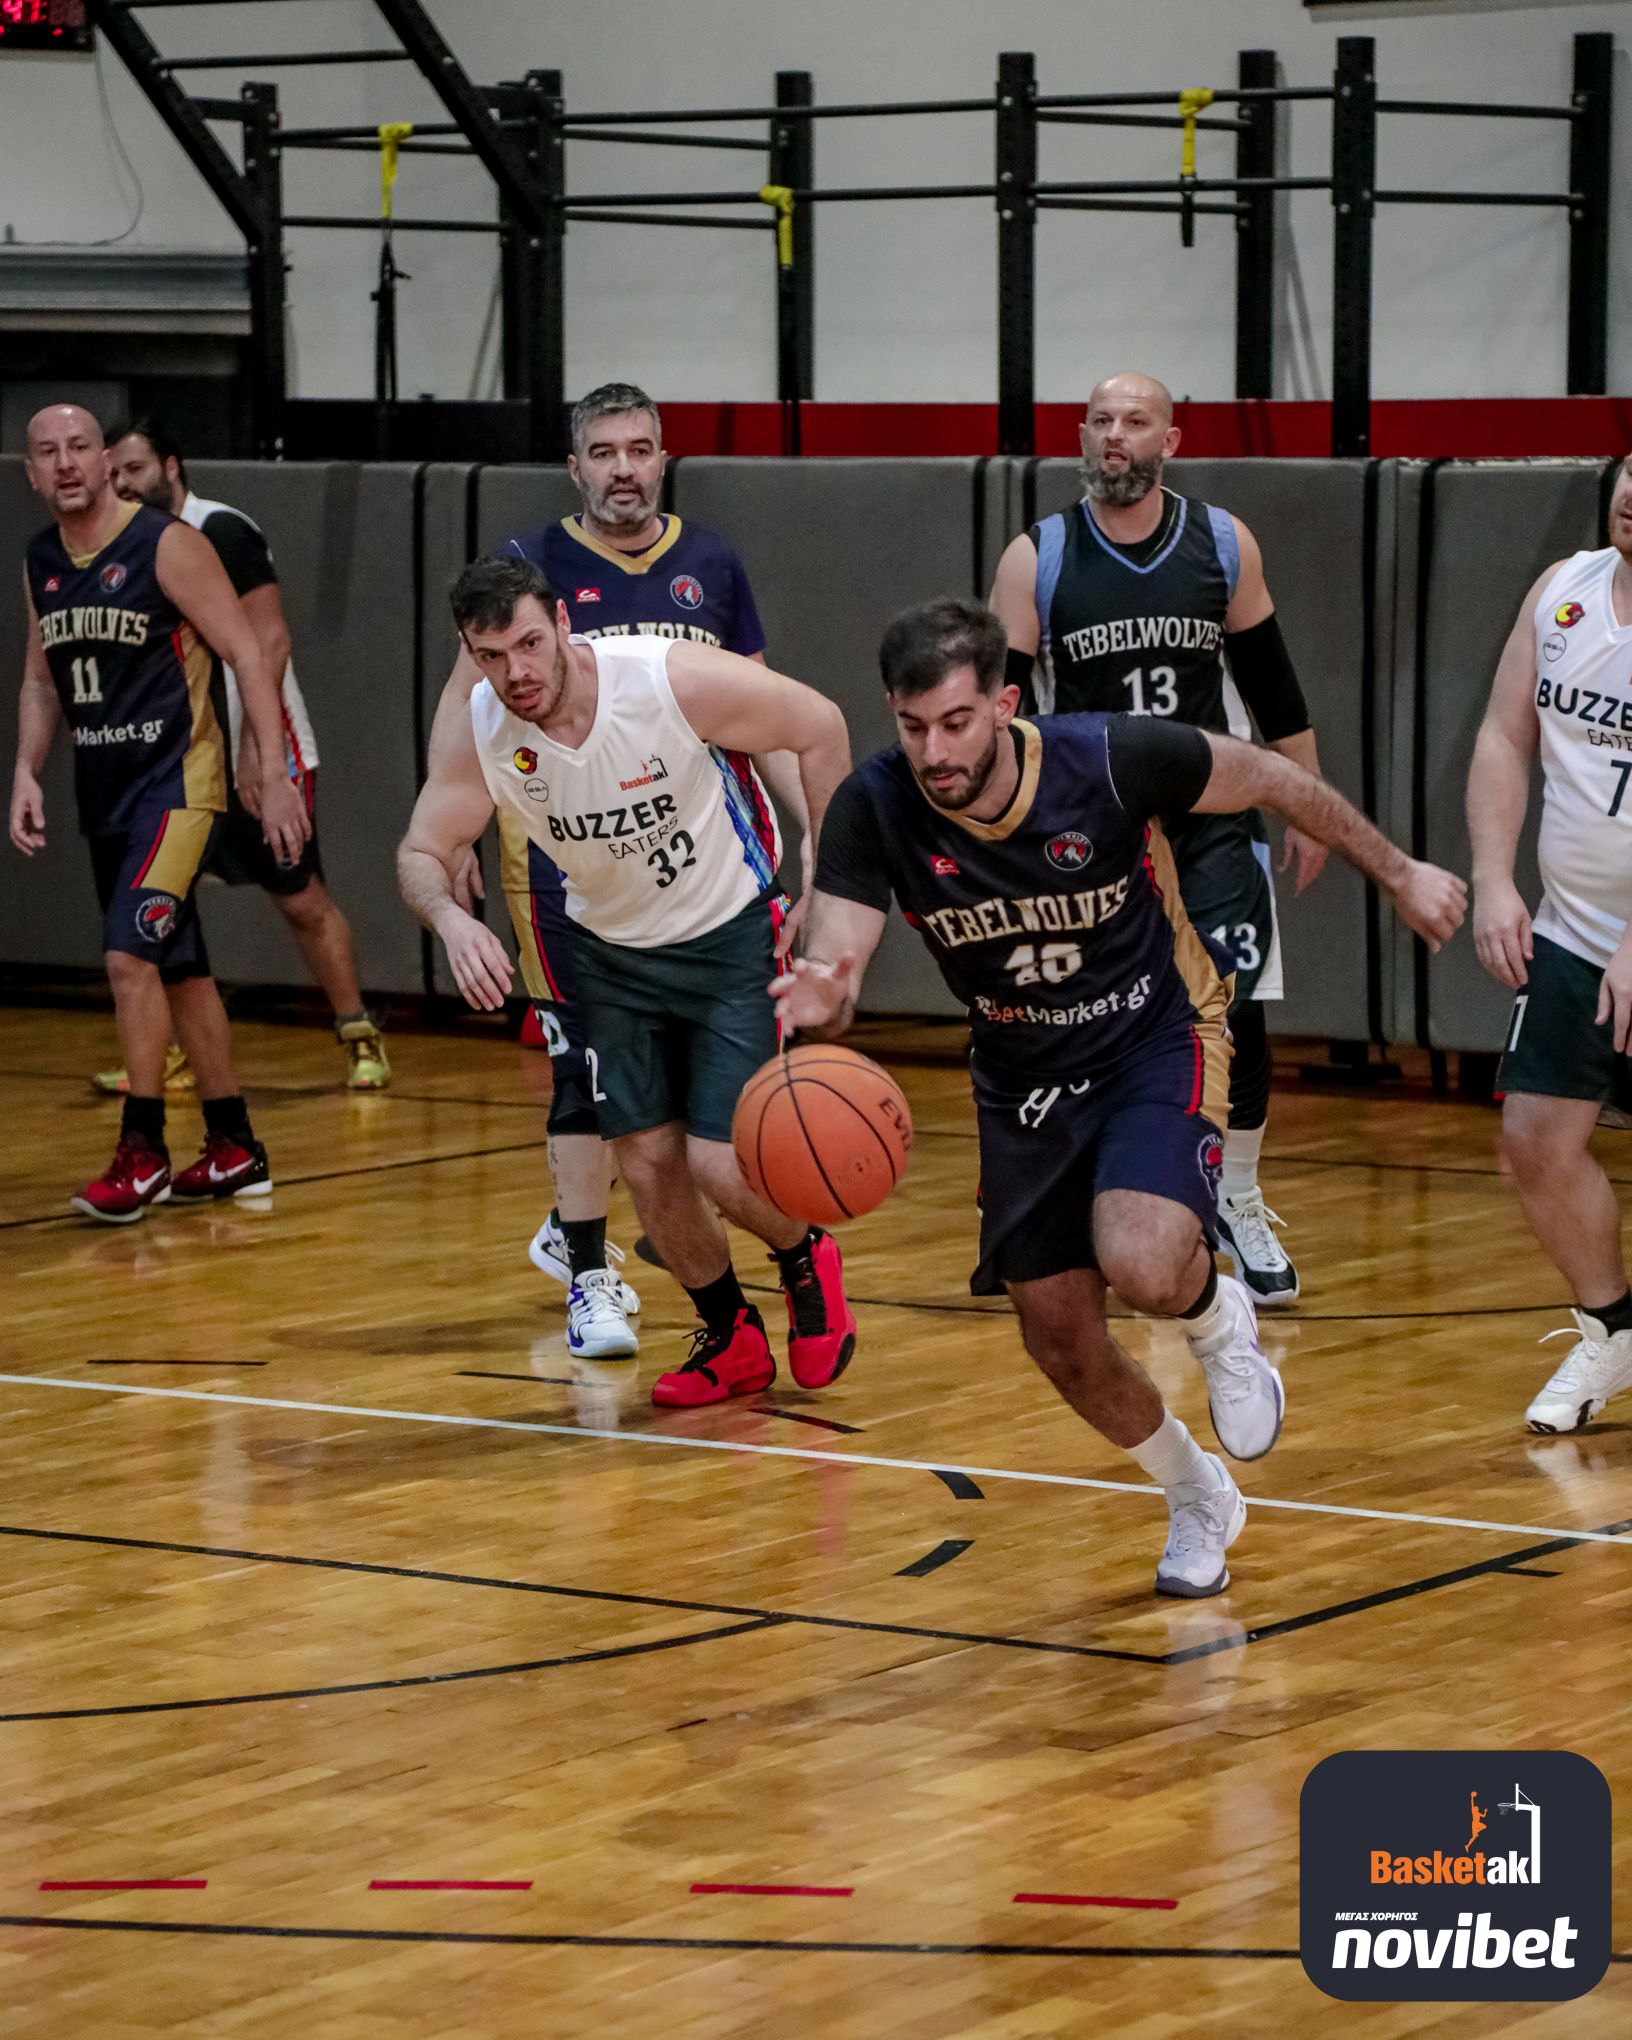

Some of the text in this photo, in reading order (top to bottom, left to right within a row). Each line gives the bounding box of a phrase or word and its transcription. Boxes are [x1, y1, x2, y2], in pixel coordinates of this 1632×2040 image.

[71, 656, 103, 703] 11
[1122, 666, 1179, 716] 13
[548, 794, 677, 841] BUZZER
[608, 816, 678, 859] EATERS
[648, 830, 696, 888] 32
[921, 875, 1129, 947] TEBELWOLVES
